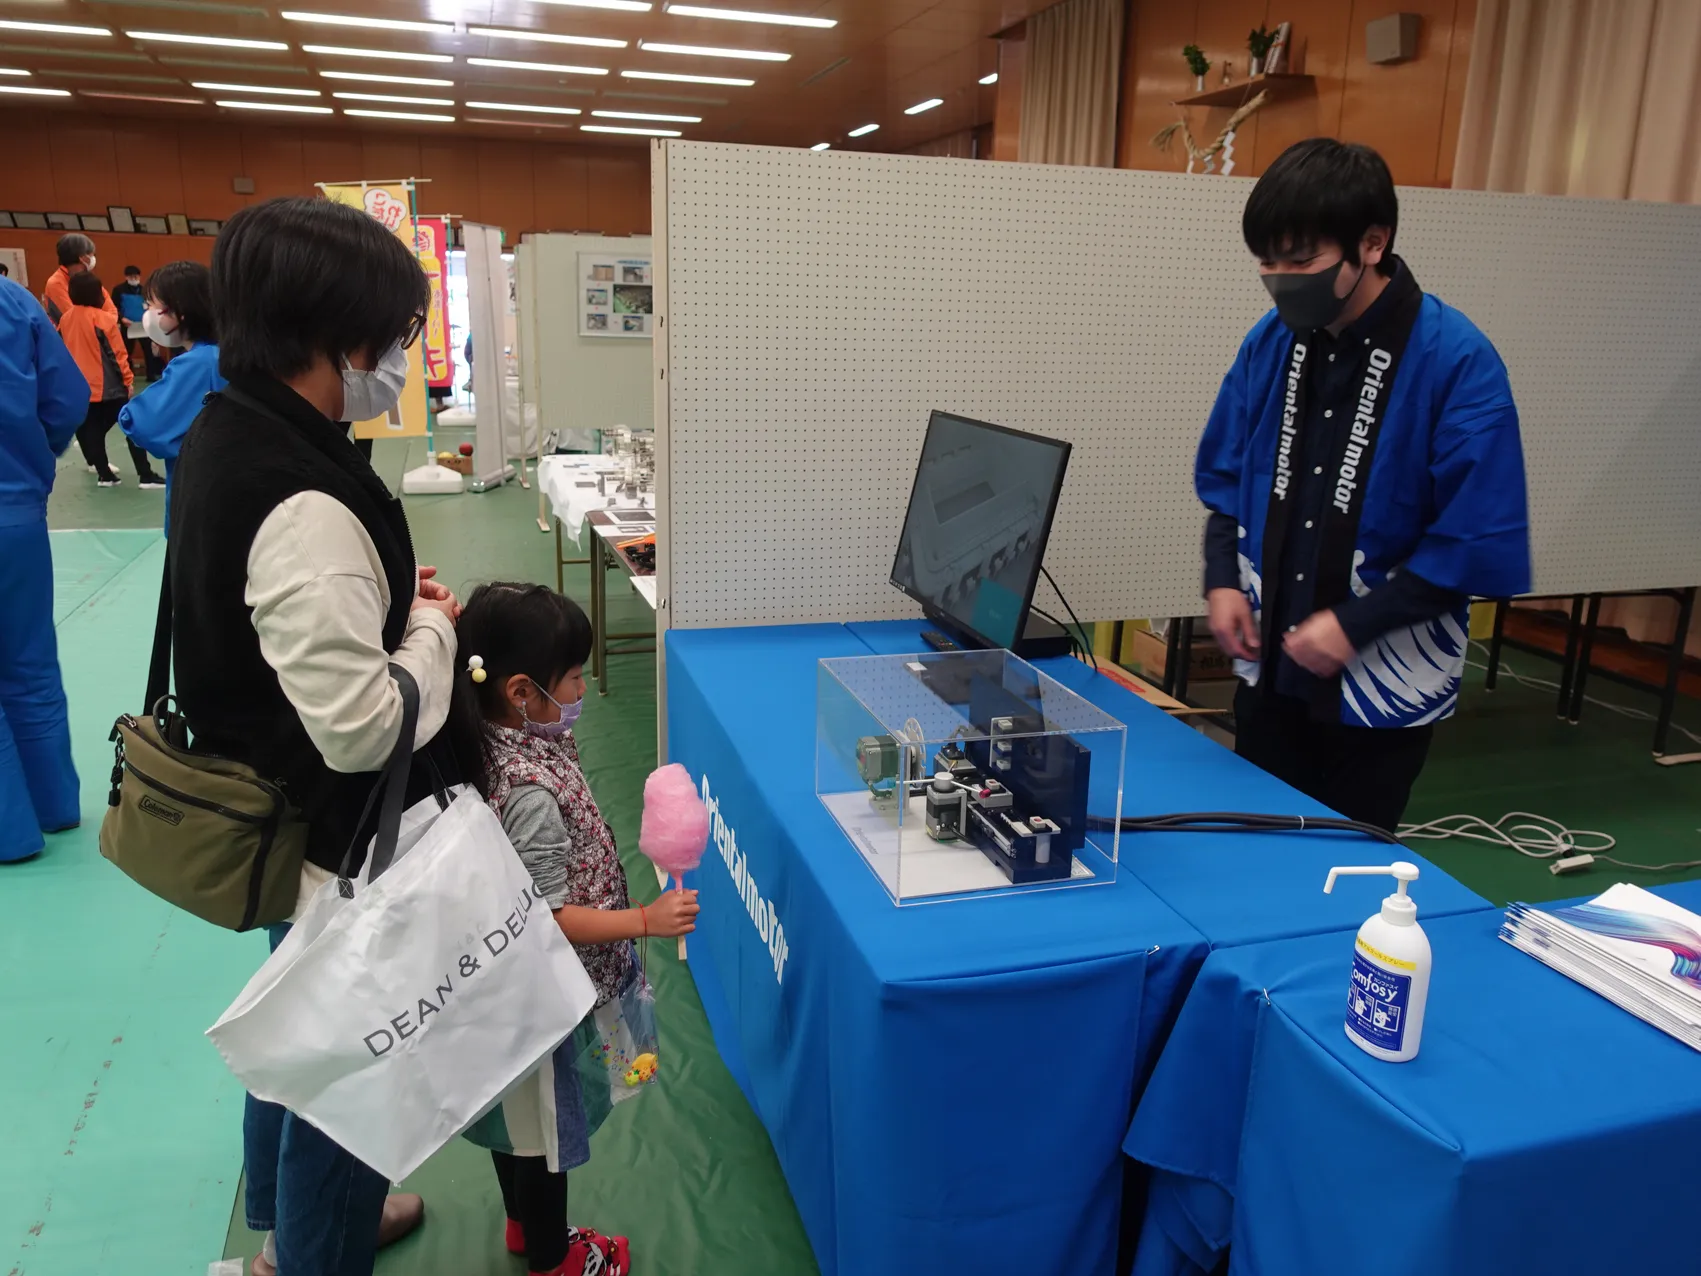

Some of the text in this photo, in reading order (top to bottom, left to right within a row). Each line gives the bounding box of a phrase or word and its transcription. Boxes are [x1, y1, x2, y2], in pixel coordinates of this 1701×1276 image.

[1274, 343, 1307, 500] Orientalmotor
[1333, 348, 1392, 514] Orientalmotor
[702, 773, 789, 985] Orientalmotor
[363, 973, 454, 1058] DEAN
[459, 954, 482, 978] &
